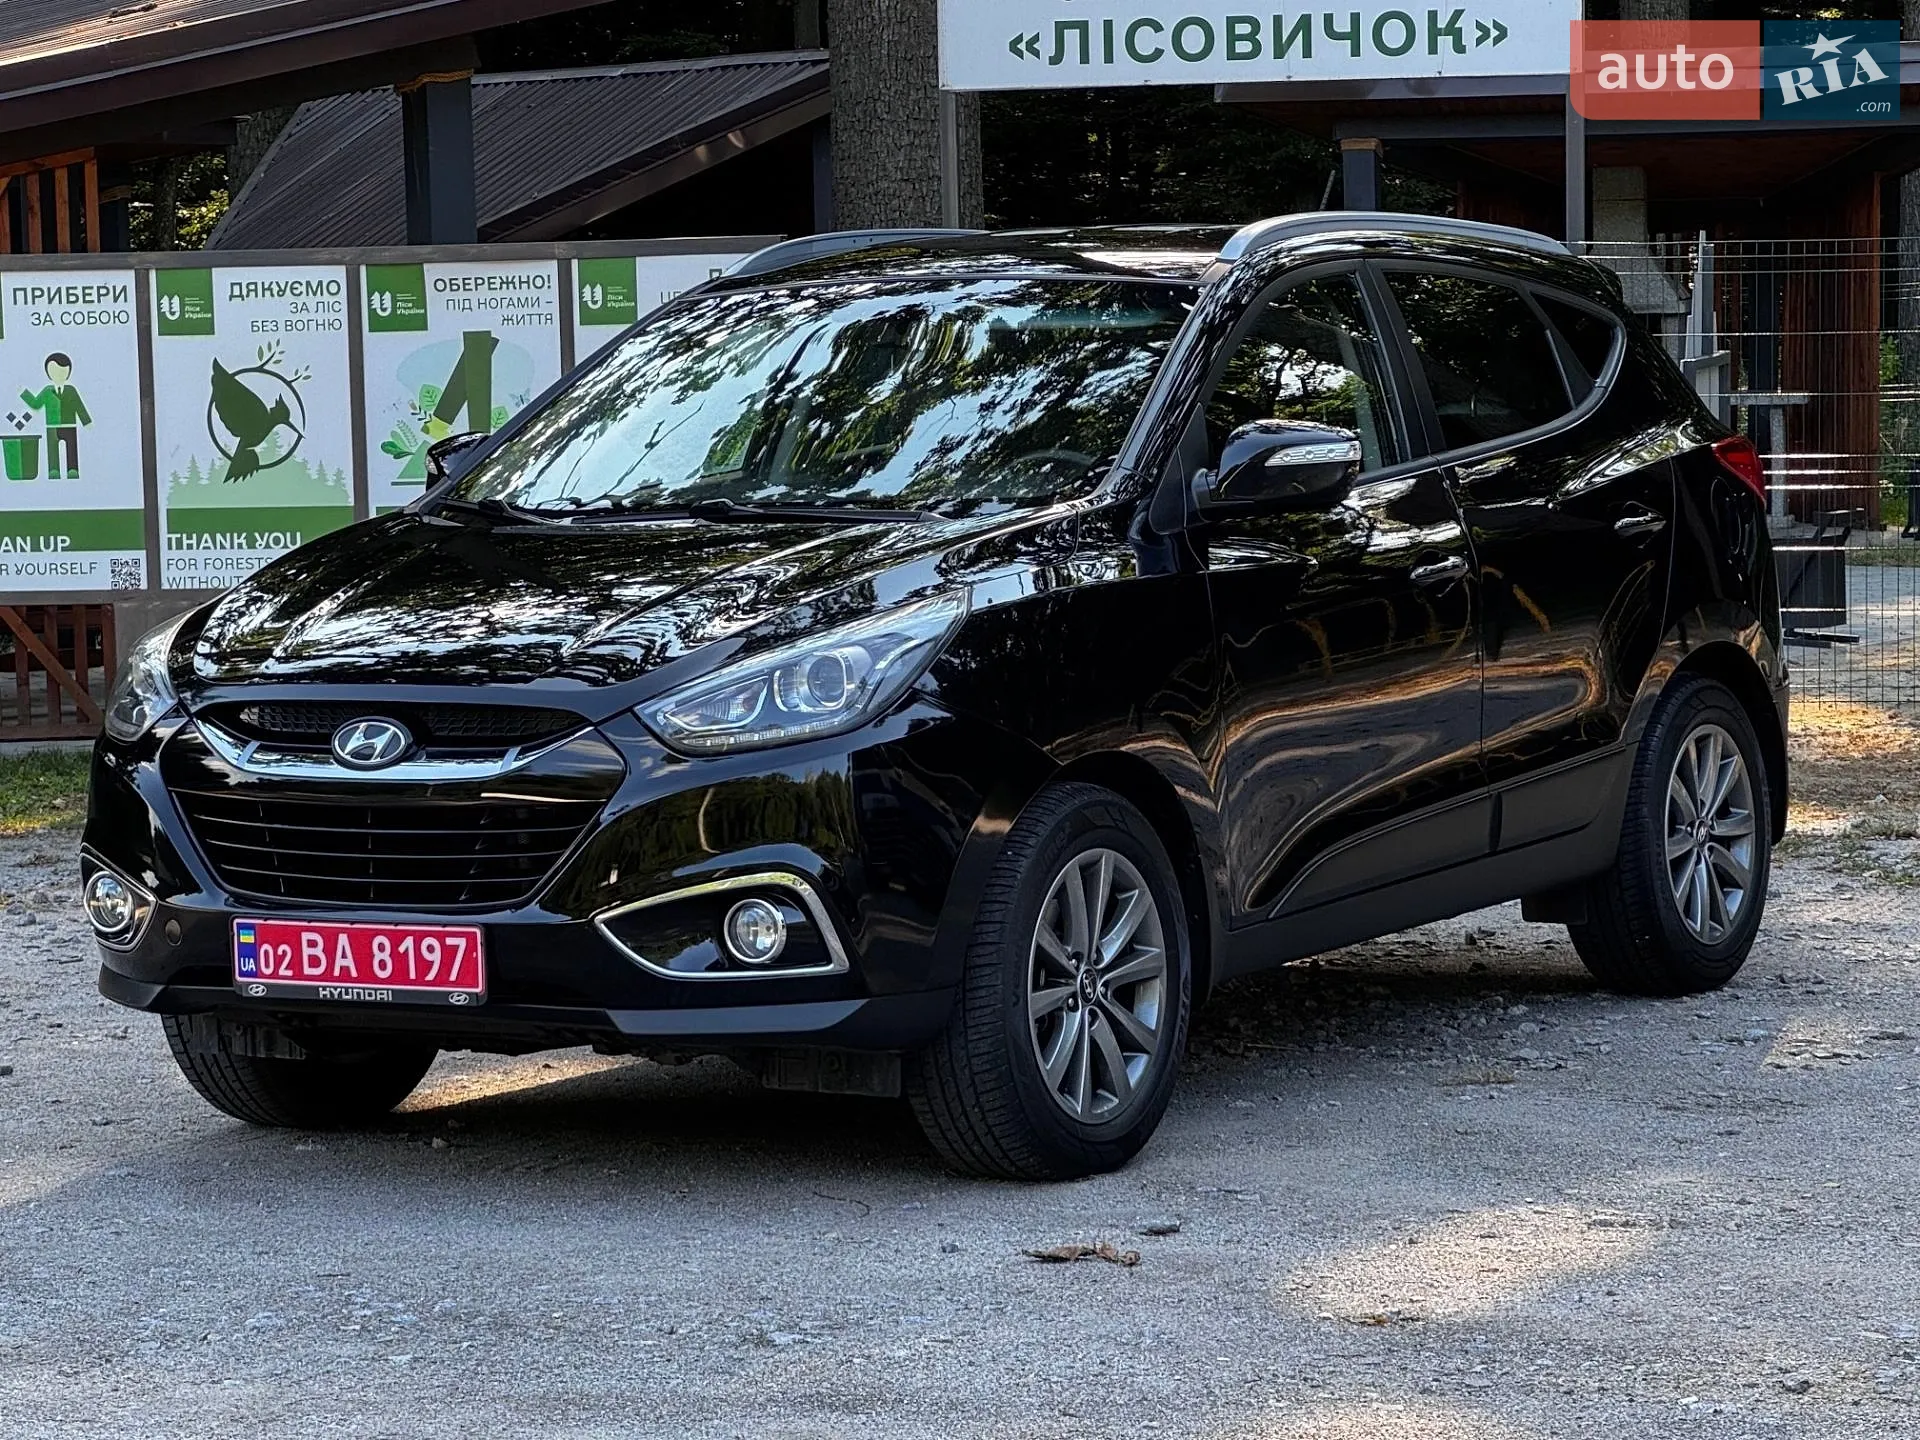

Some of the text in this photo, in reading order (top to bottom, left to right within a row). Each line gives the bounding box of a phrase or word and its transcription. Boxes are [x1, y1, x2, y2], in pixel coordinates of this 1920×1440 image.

[1008, 9, 1509, 66] «ЛІСОВИЧОК»
[228, 280, 342, 302] ДЯКУЄМО
[433, 274, 552, 293] ОБЕРЕЖНО!
[12, 284, 128, 306] ПРИБЕРИ
[289, 300, 342, 314] ЗА ЛІС
[446, 298, 473, 312] ПІД
[477, 297, 541, 310] НОГАМИ
[31, 309, 130, 326] ЗА СОБОЮ
[251, 318, 343, 333] БЕЗ ВОГНЮ
[501, 313, 553, 326] ЖИТТЯ
[40, 535, 71, 552] UP
[167, 531, 301, 550] THANK YOU
[15, 561, 98, 576] YOURSELF
[167, 558, 198, 571] FOR
[167, 575, 244, 589] WITHOUT
[240, 957, 256, 972] UA
[259, 943, 294, 977] 02
[371, 935, 467, 982] 8197
[318, 987, 393, 1001] HYUNDAI
